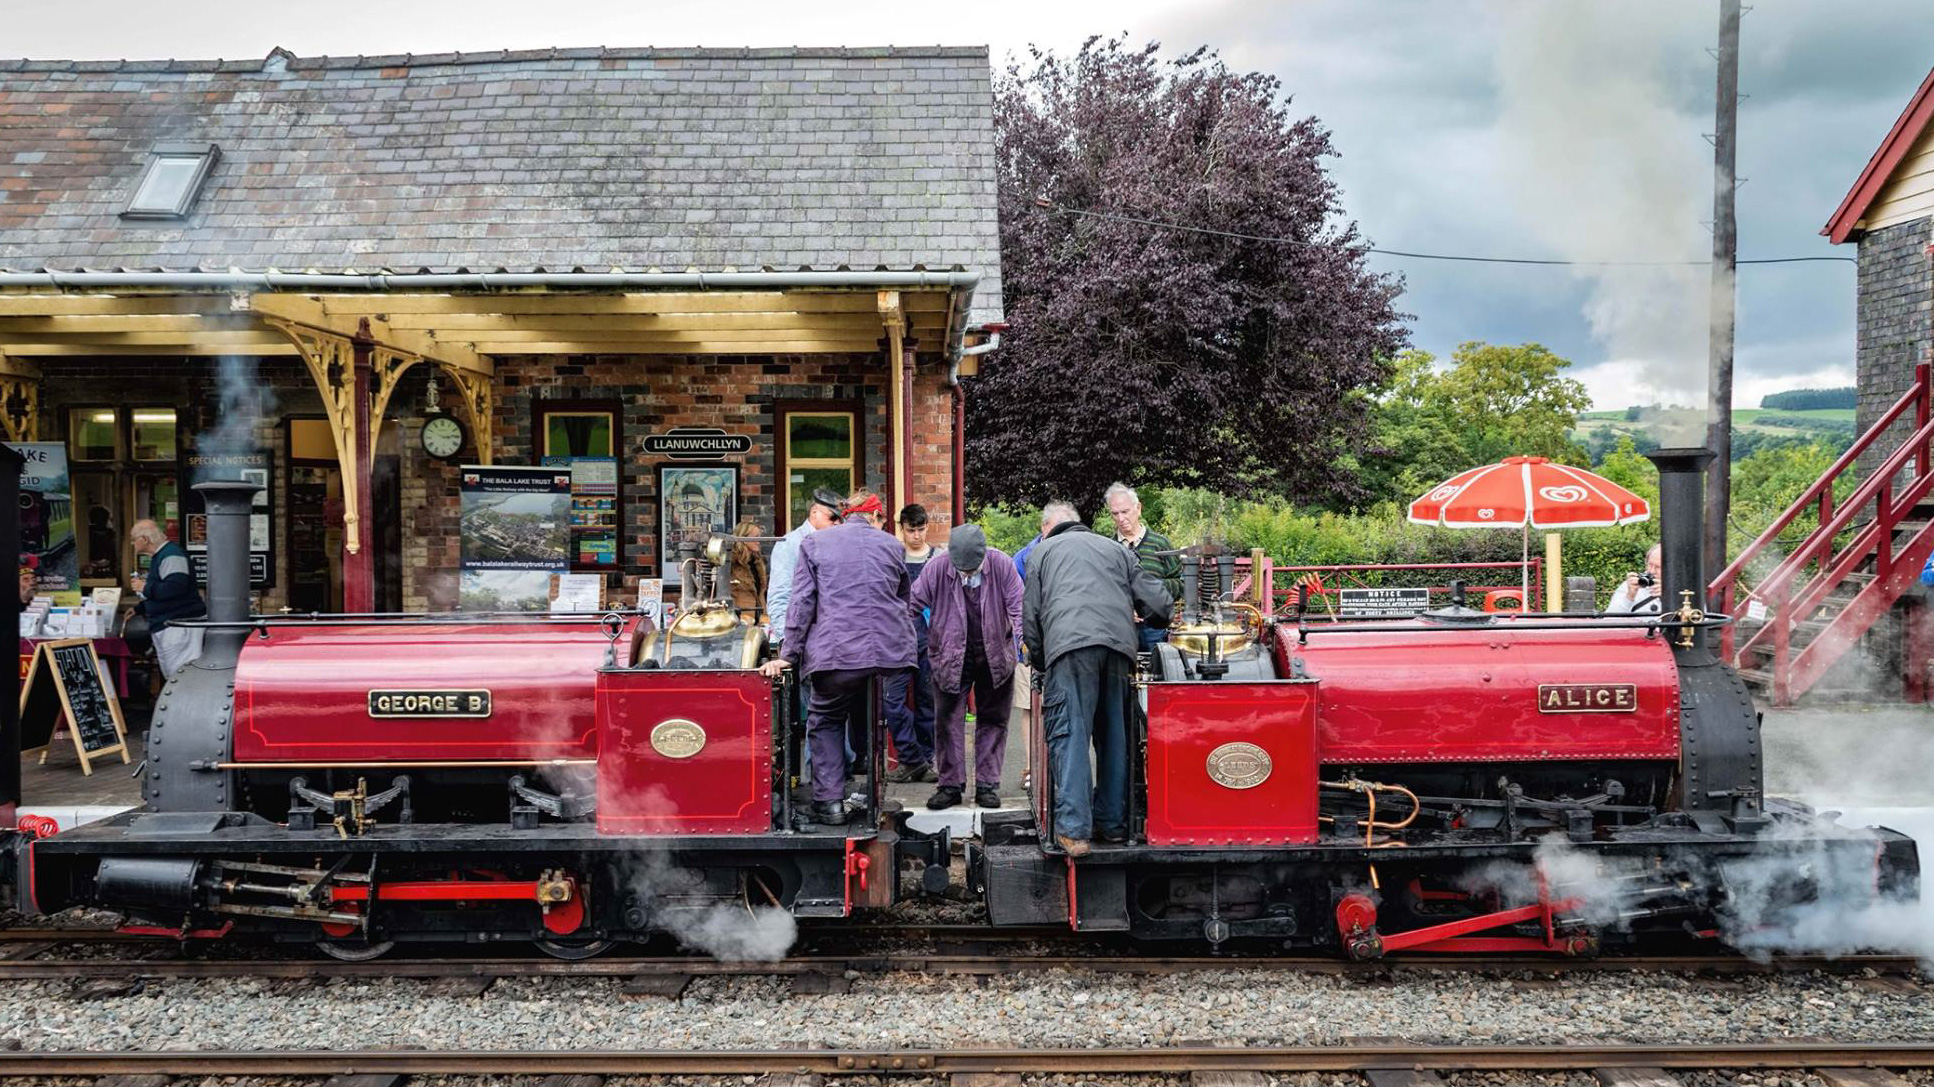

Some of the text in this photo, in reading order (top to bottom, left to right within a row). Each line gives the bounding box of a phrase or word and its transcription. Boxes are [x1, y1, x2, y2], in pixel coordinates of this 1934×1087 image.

[654, 439, 741, 450] LLANUWCHLLYN
[18, 448, 48, 463] AKE
[188, 456, 262, 465] SPECIAL NOTICES
[19, 476, 41, 486] GID
[465, 560, 564, 569] www.balalakerailwaytrust.org.uk
[377, 695, 481, 711] GEORGE B
[1547, 689, 1628, 706] ALICE
